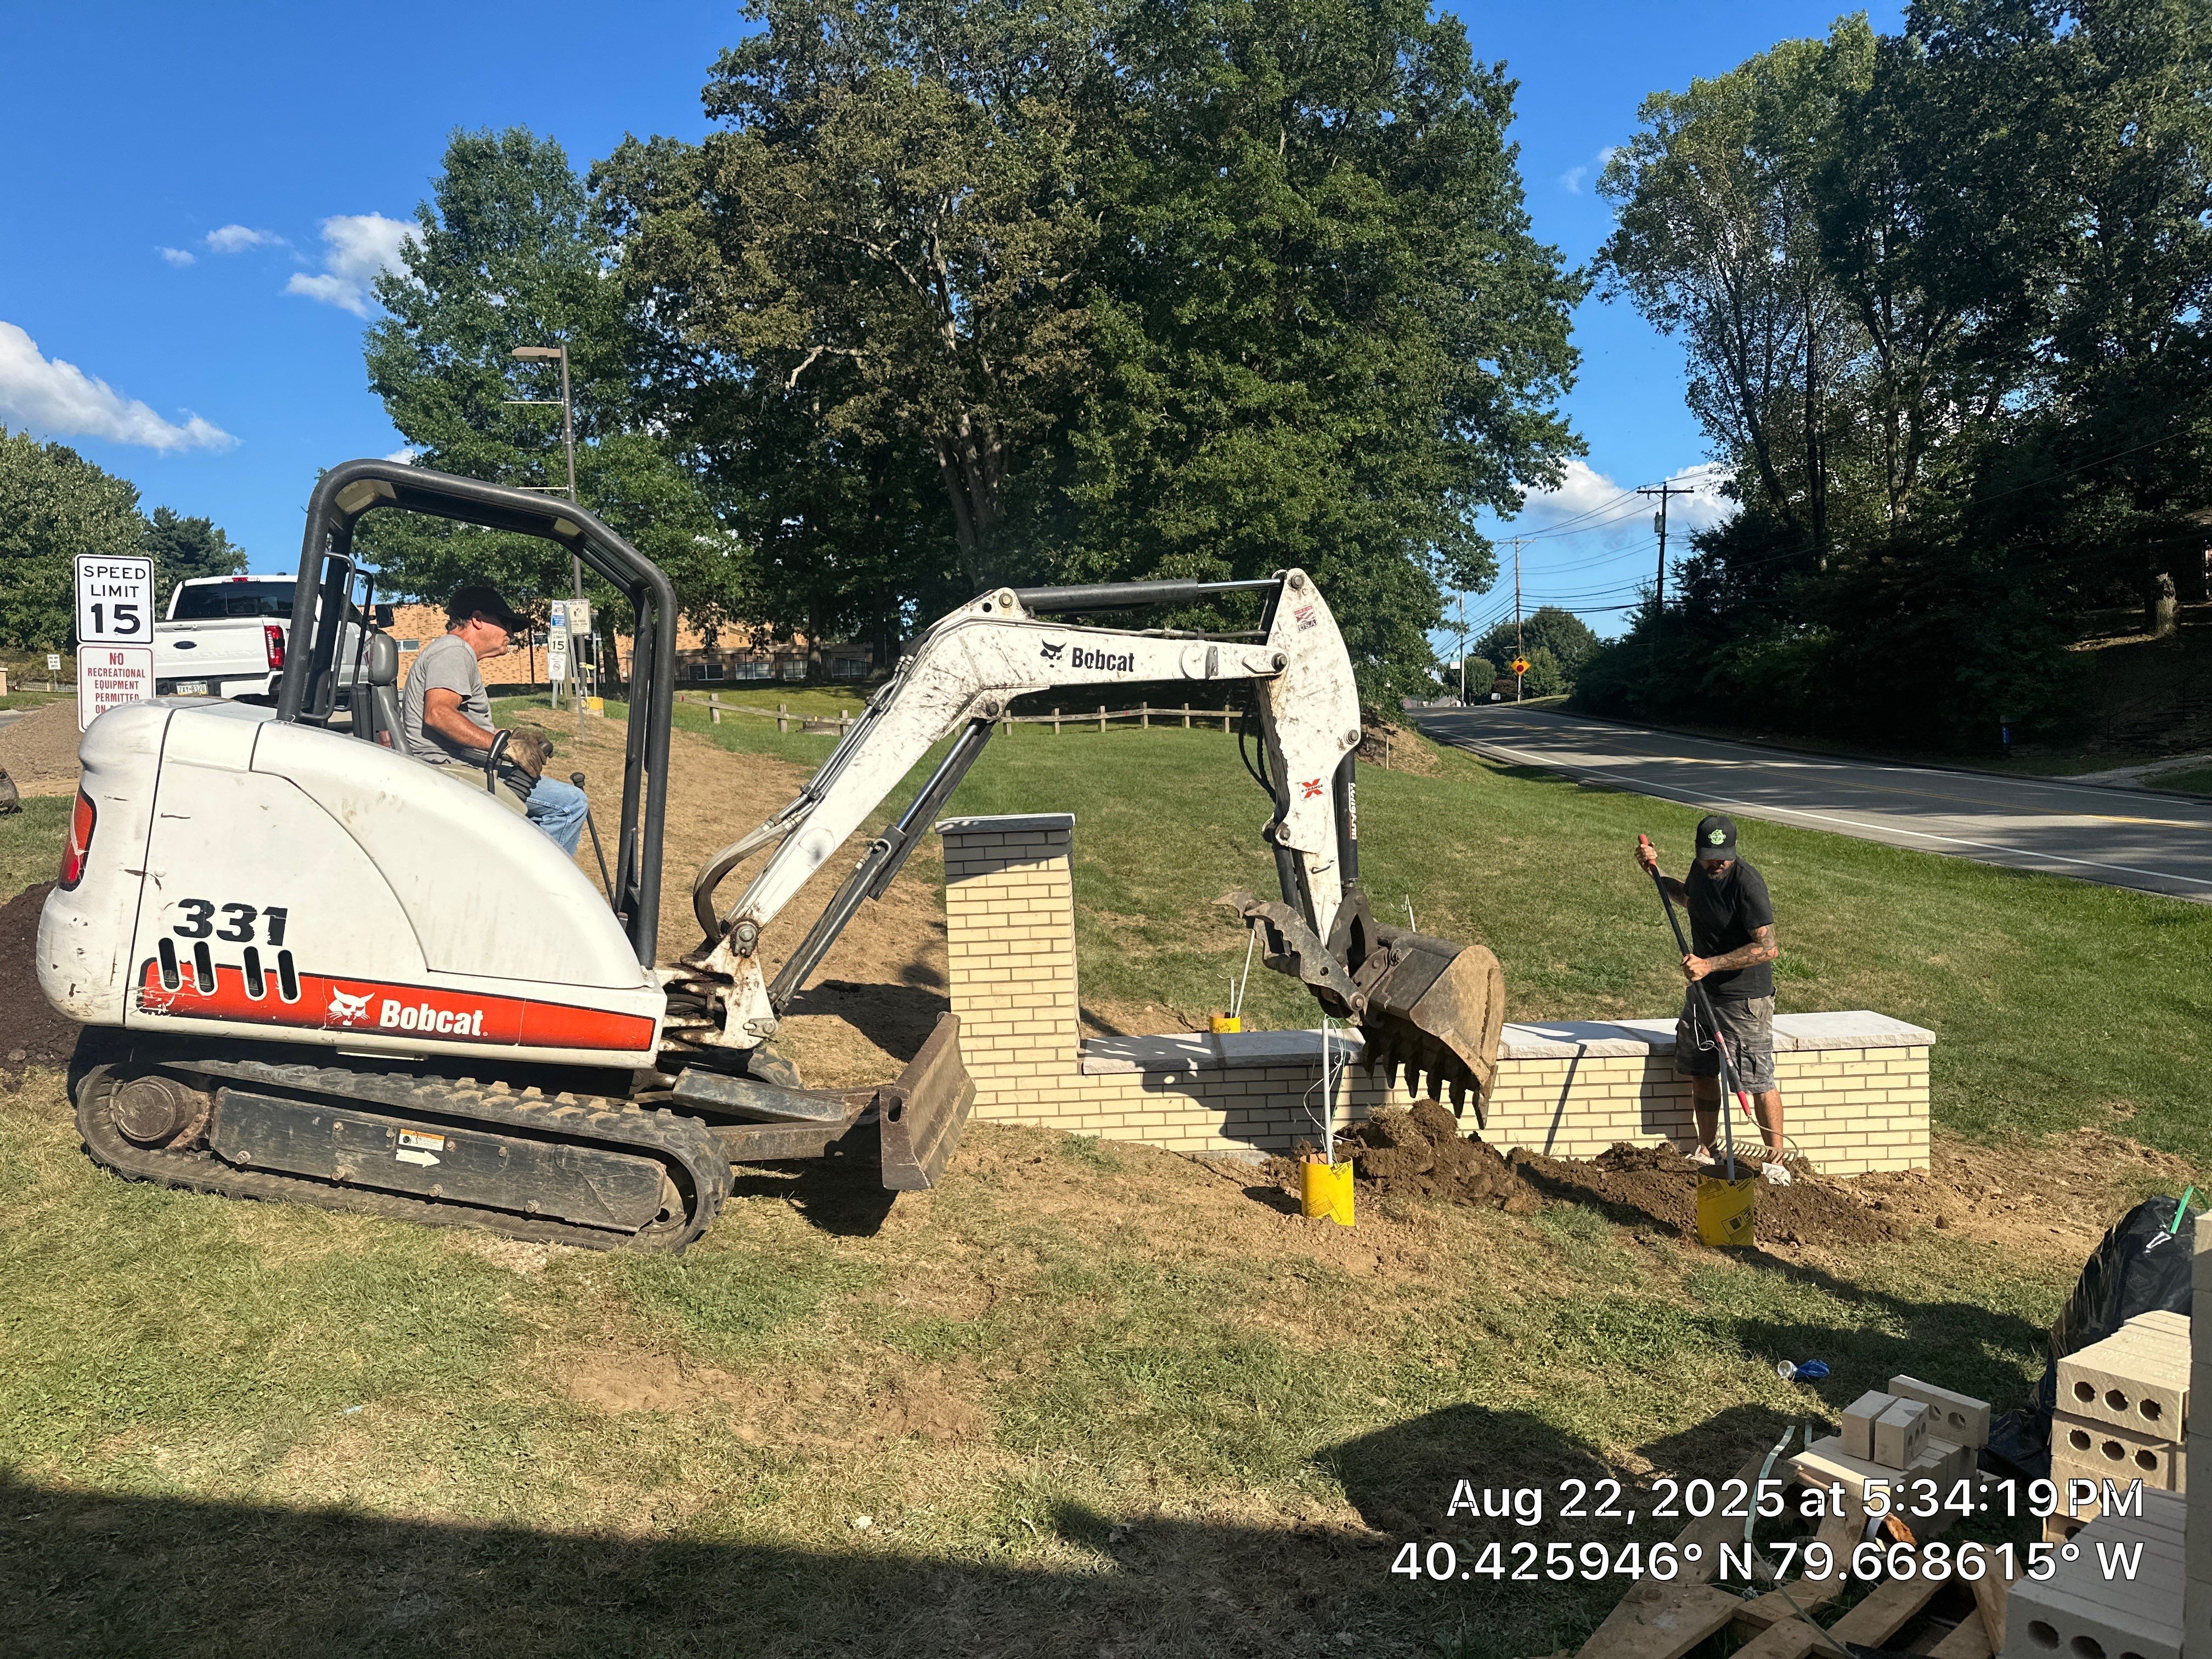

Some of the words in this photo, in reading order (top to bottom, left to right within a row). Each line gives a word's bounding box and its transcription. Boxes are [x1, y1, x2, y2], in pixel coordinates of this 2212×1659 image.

[83, 566, 146, 579] SPEED
[91, 584, 139, 597] LIMIT
[91, 603, 140, 634] 15
[1299, 619, 1316, 631] USA
[552, 641, 565, 650] 15
[109, 652, 124, 665] NO
[1071, 647, 1135, 673] Bobcat
[87, 668, 146, 678] RECREATIONAL
[94, 680, 139, 690] EQUIPMENT
[95, 692, 139, 702] PERMITTED
[95, 704, 106, 714] ON
[173, 898, 288, 946] 331
[379, 999, 484, 1036] Bobcat
